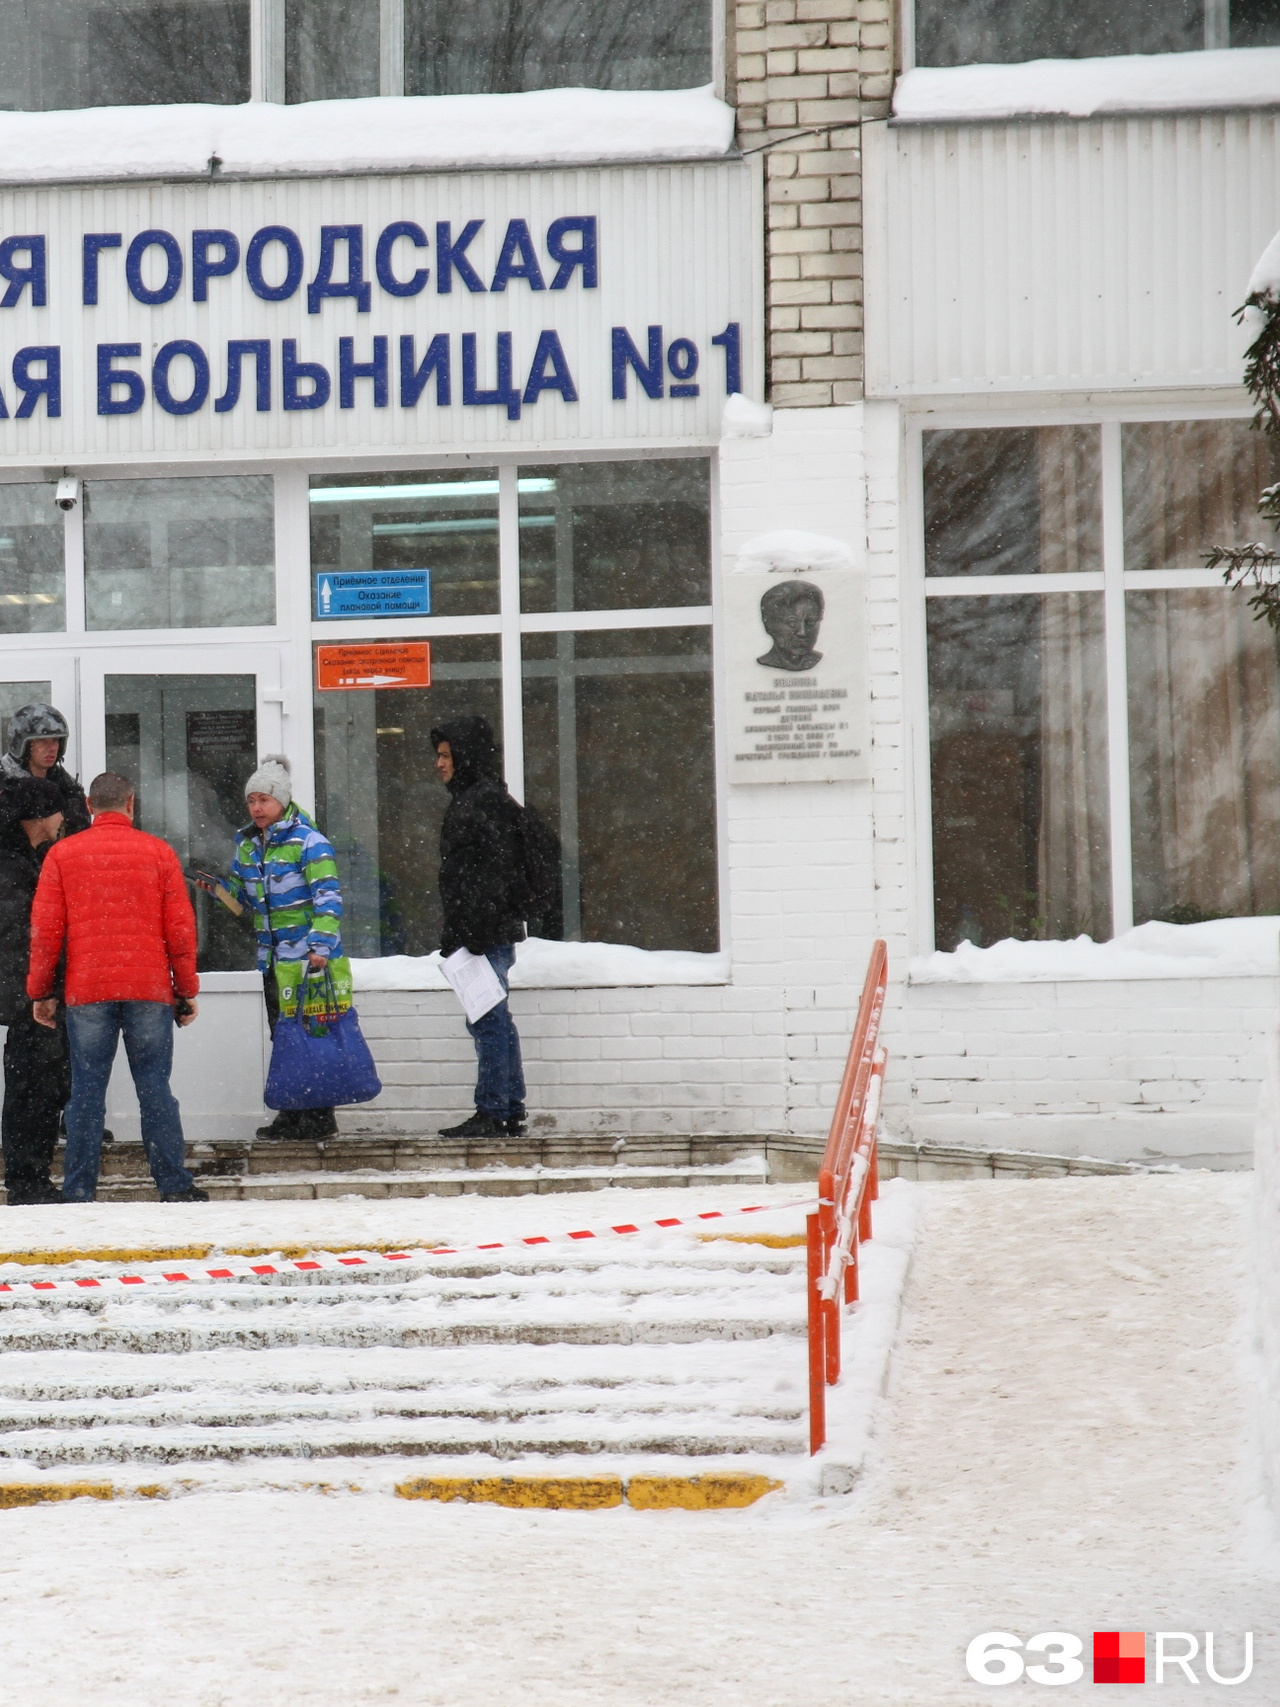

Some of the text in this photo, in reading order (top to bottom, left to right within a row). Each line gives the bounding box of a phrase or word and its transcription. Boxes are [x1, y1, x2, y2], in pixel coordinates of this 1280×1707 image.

[82, 217, 597, 314] ГОРОДСКАЯ
[96, 330, 577, 421] БОЛЬНИЦА
[611, 324, 741, 400] №1
[333, 575, 426, 588] Приёмное отделение
[357, 590, 402, 601] Оказание
[340, 601, 421, 612] плановой помощи
